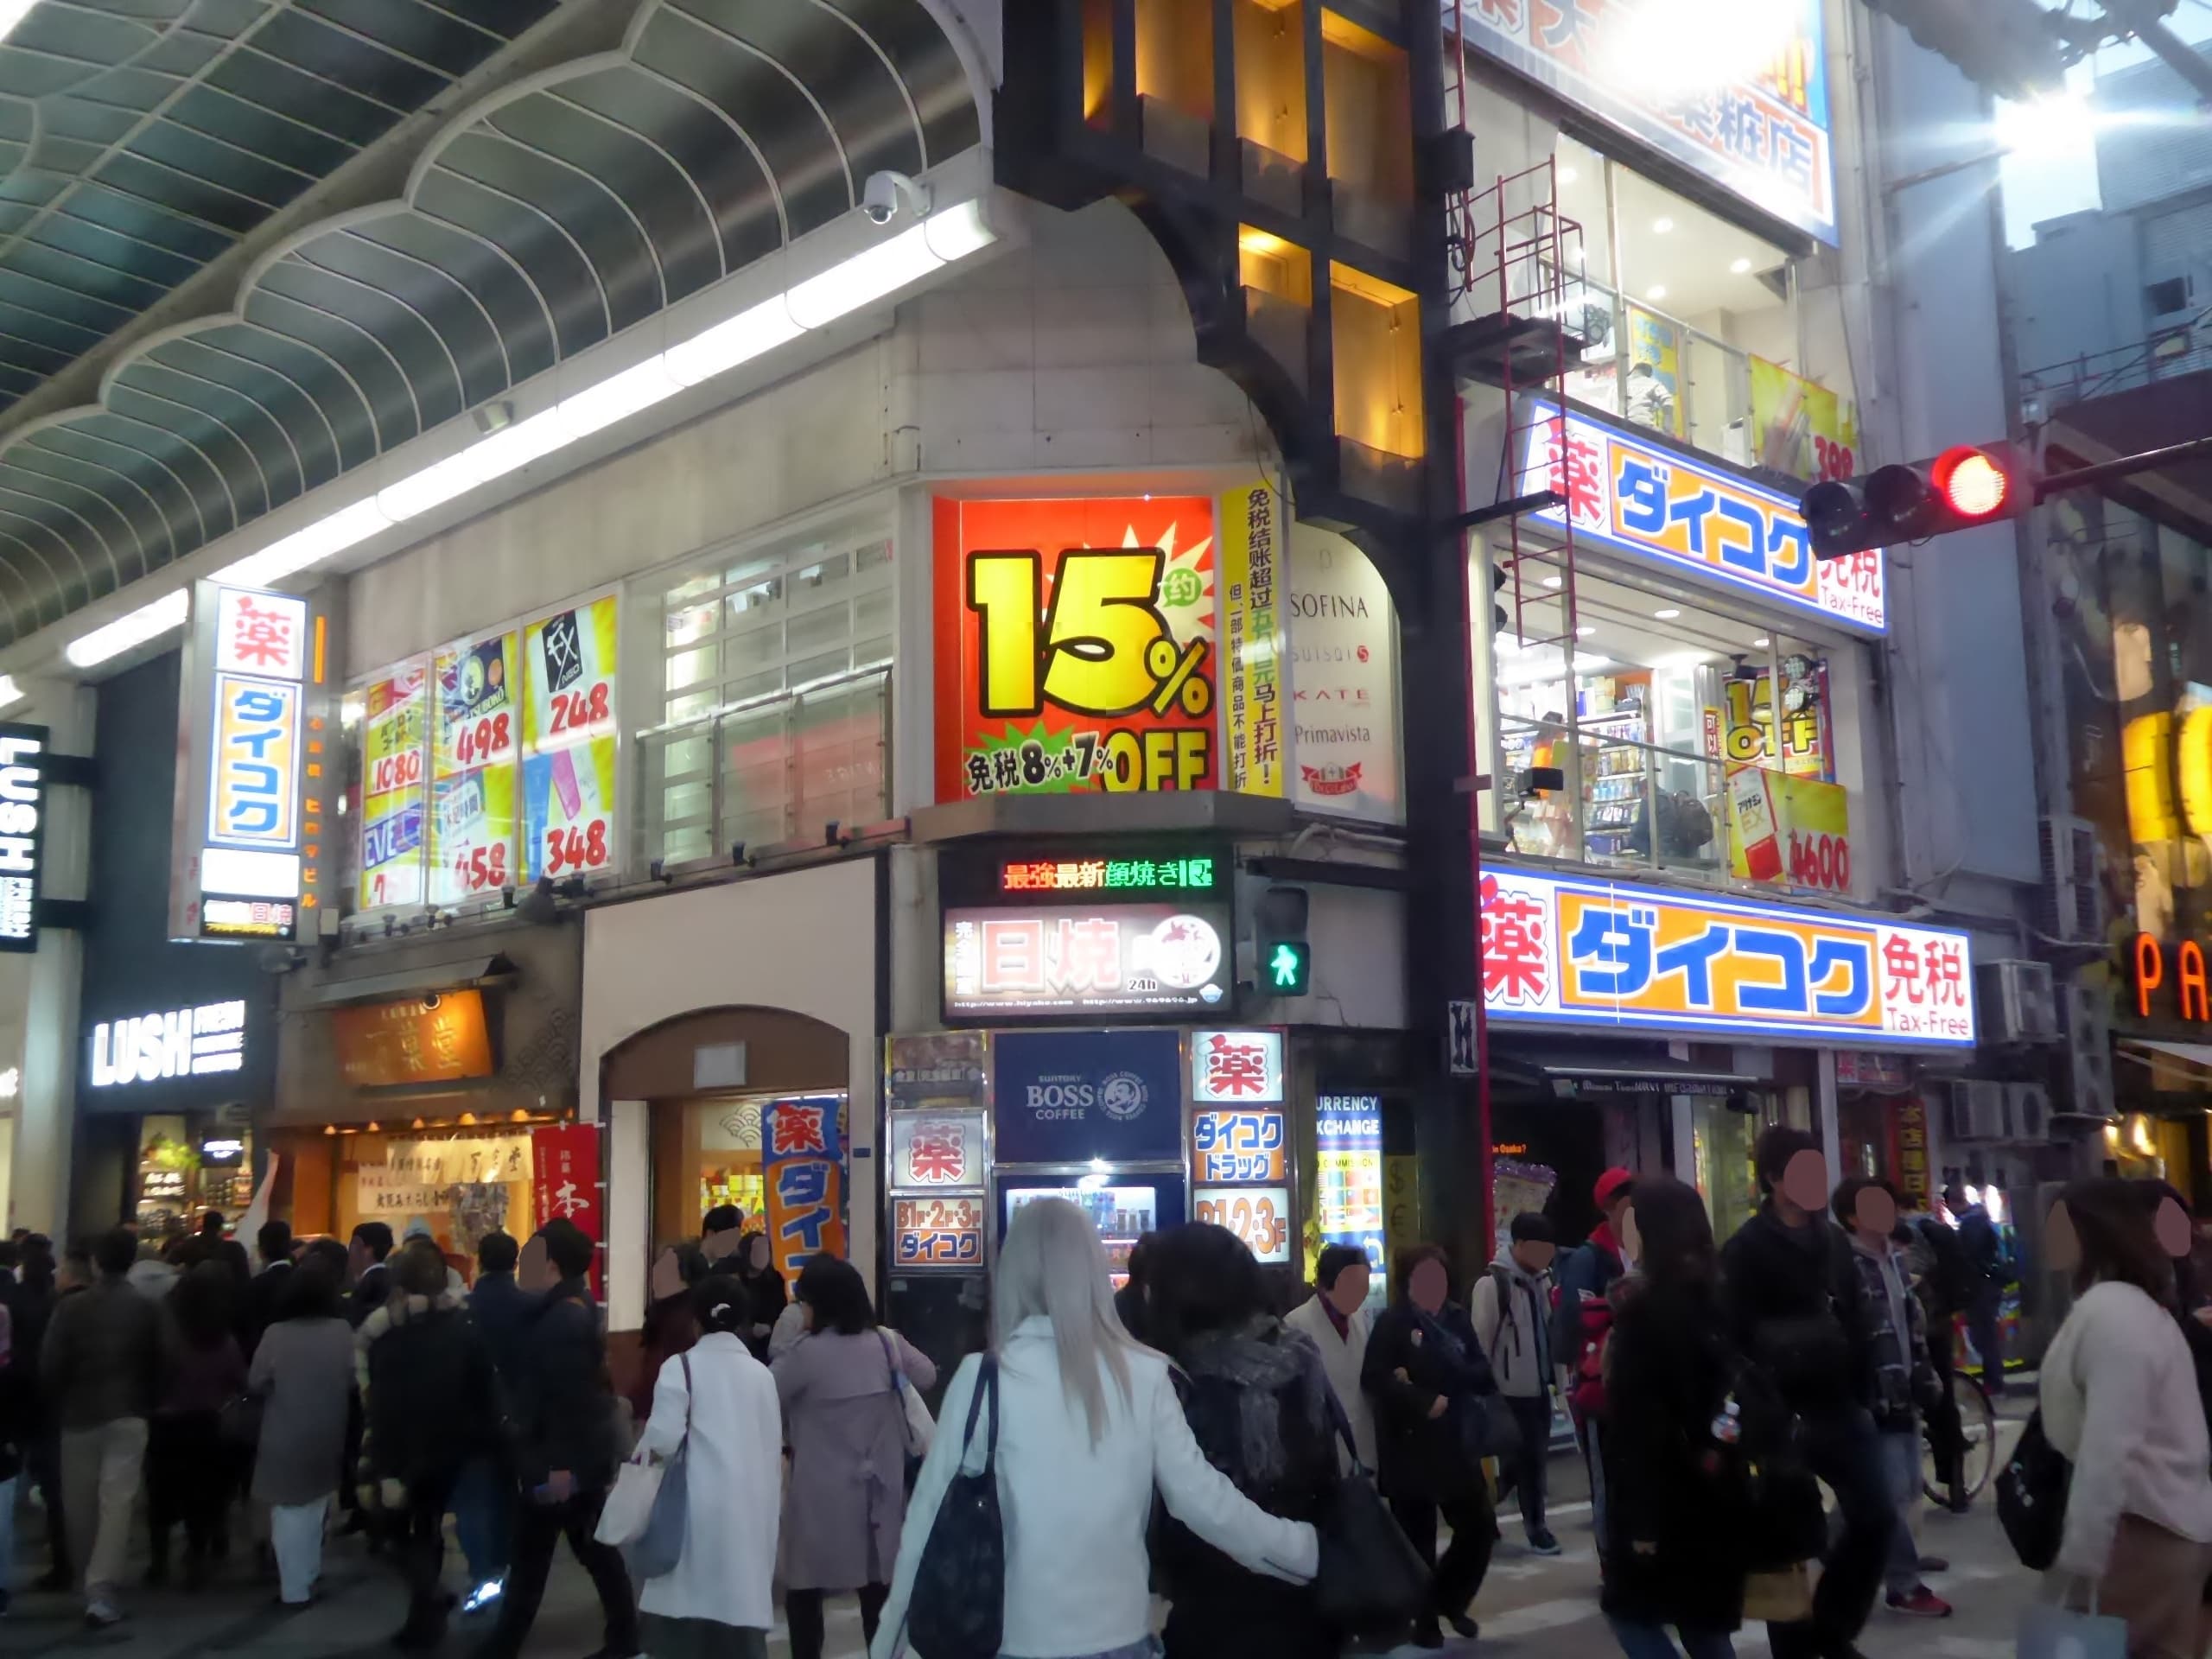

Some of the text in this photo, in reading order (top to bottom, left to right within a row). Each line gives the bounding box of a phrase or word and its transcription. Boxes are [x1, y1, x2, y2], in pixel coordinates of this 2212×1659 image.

[1545, 416, 1603, 520] 薬
[1618, 461, 1810, 584] ダイコク
[1291, 593, 1369, 620] SOFINA
[1821, 585, 1883, 624] Tax-Free
[234, 596, 291, 666] 薬
[967, 548, 1212, 718] 15%
[550, 682, 608, 734] 248
[228, 690, 287, 832] ダイコク
[456, 712, 510, 764] 498
[1103, 728, 1208, 791] OFF
[1295, 726, 1371, 747] Primavista
[364, 819, 397, 868] EVE
[546, 819, 606, 874] 348
[982, 918, 1122, 994] 日焼
[1481, 874, 1966, 1014] 薬 ダイコク 免税
[1128, 978, 1157, 991] 24h
[92, 1008, 192, 1086] LUSH
[1888, 1006, 1969, 1036] Tax-Free
[1198, 1034, 1265, 1096] 薬
[1027, 1084, 1094, 1108] BOSS
[1035, 1109, 1085, 1121] COFFEE
[776, 1103, 826, 1154] 薬
[912, 1122, 963, 1180] 薬
[1195, 1115, 1283, 1150] ダイコク
[1206, 1154, 1270, 1180] ドラッグ
[901, 1233, 978, 1259] ダイコク
